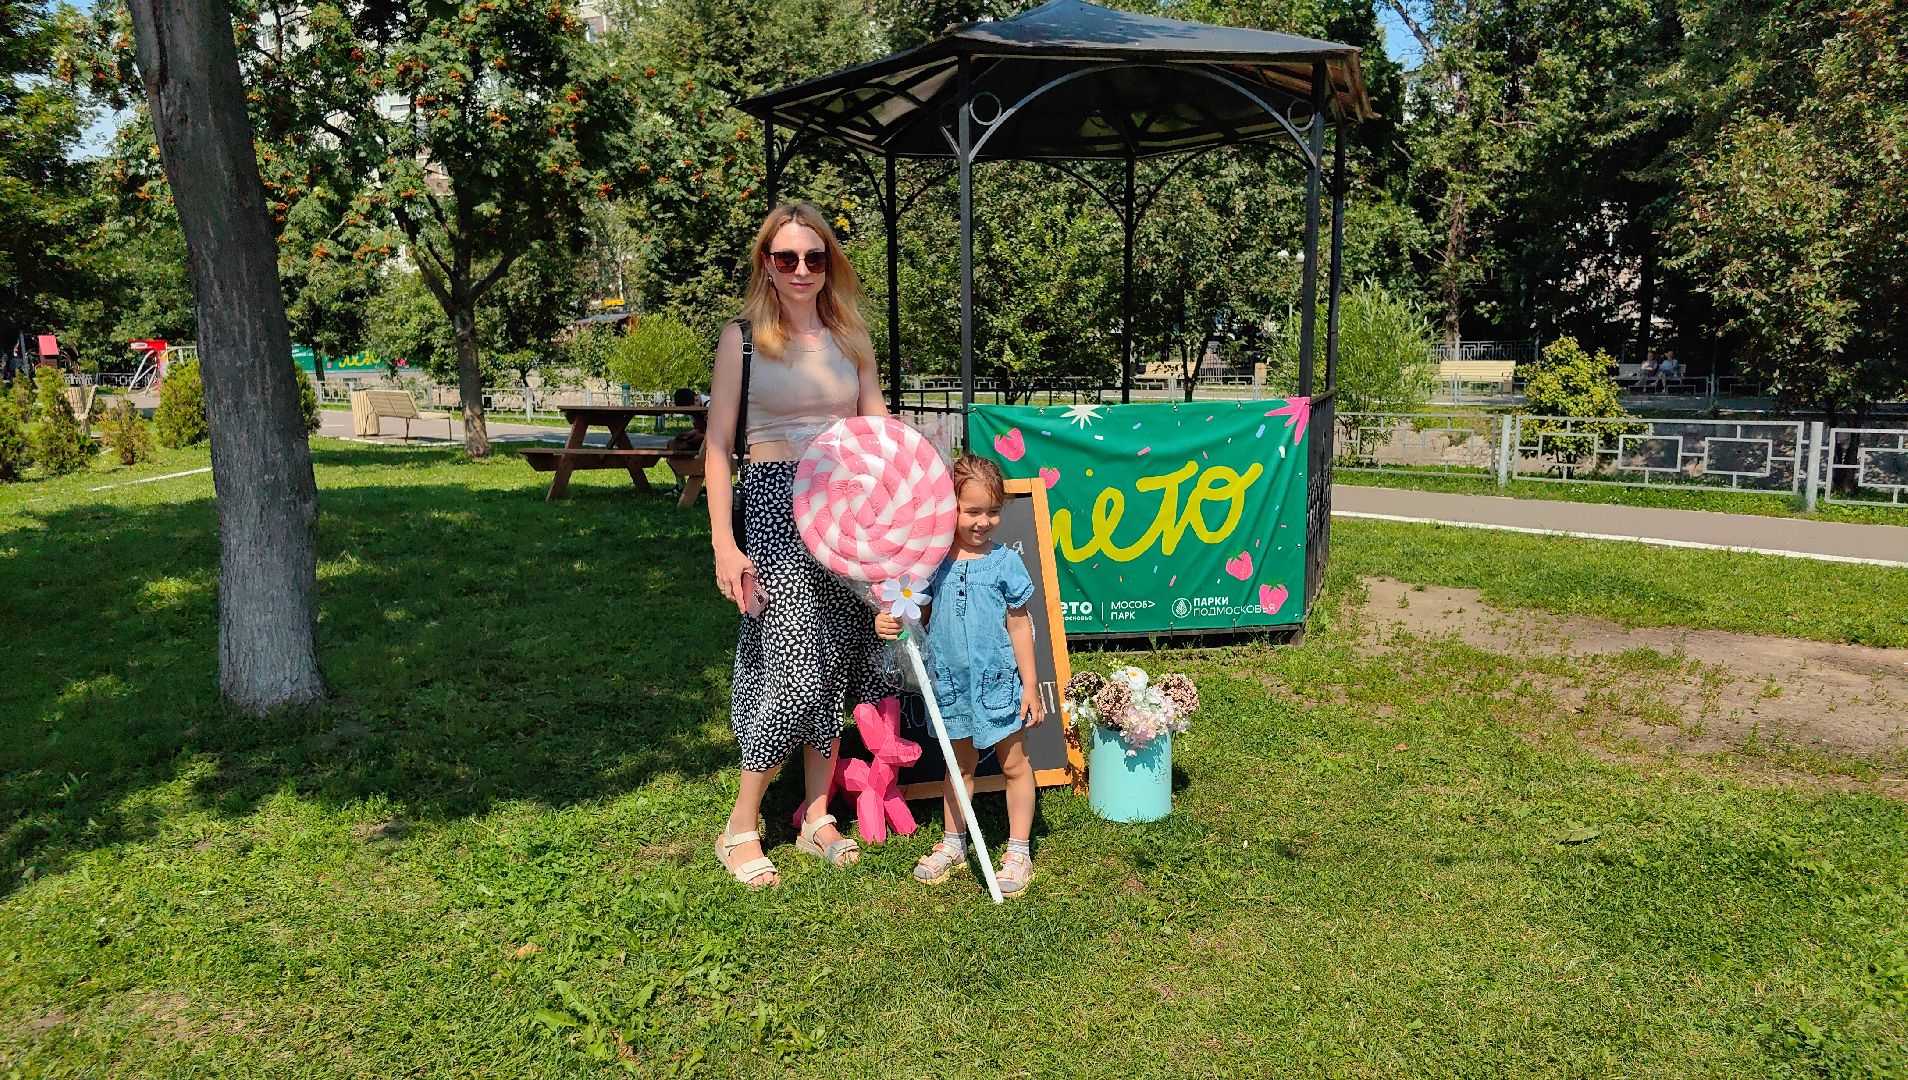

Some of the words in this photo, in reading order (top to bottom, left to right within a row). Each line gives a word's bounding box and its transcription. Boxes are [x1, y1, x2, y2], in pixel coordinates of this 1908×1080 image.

[1193, 596, 1229, 607] ПАРКИ
[1060, 601, 1093, 615] ето
[1193, 603, 1275, 617] ПОДМОСКОВЬЯ
[1110, 611, 1136, 621] ПАРК
